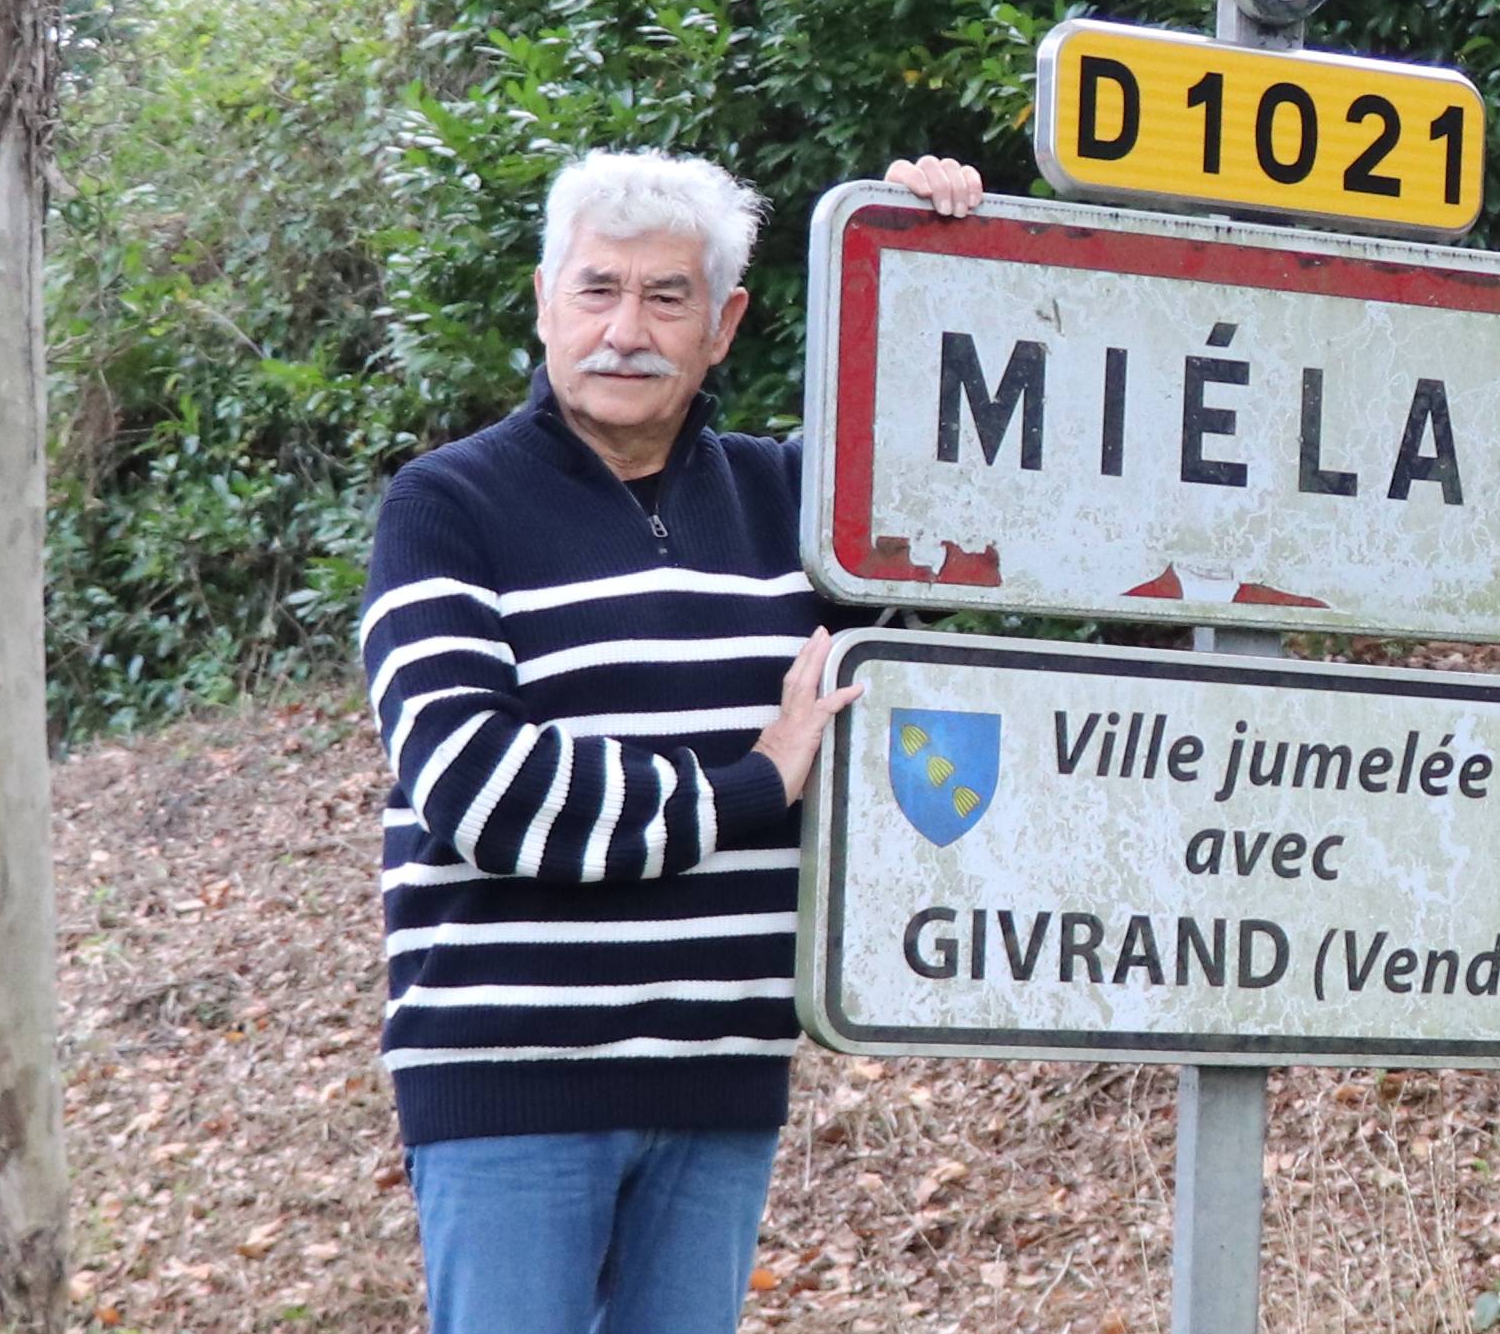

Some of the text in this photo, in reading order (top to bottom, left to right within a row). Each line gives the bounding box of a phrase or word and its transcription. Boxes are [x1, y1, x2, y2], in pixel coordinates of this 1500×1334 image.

[1076, 53, 1465, 207] D 1021
[1053, 710, 1493, 803] Ville jumelée
[1184, 827, 1345, 882] avec
[902, 906, 1290, 990] GIVRAND
